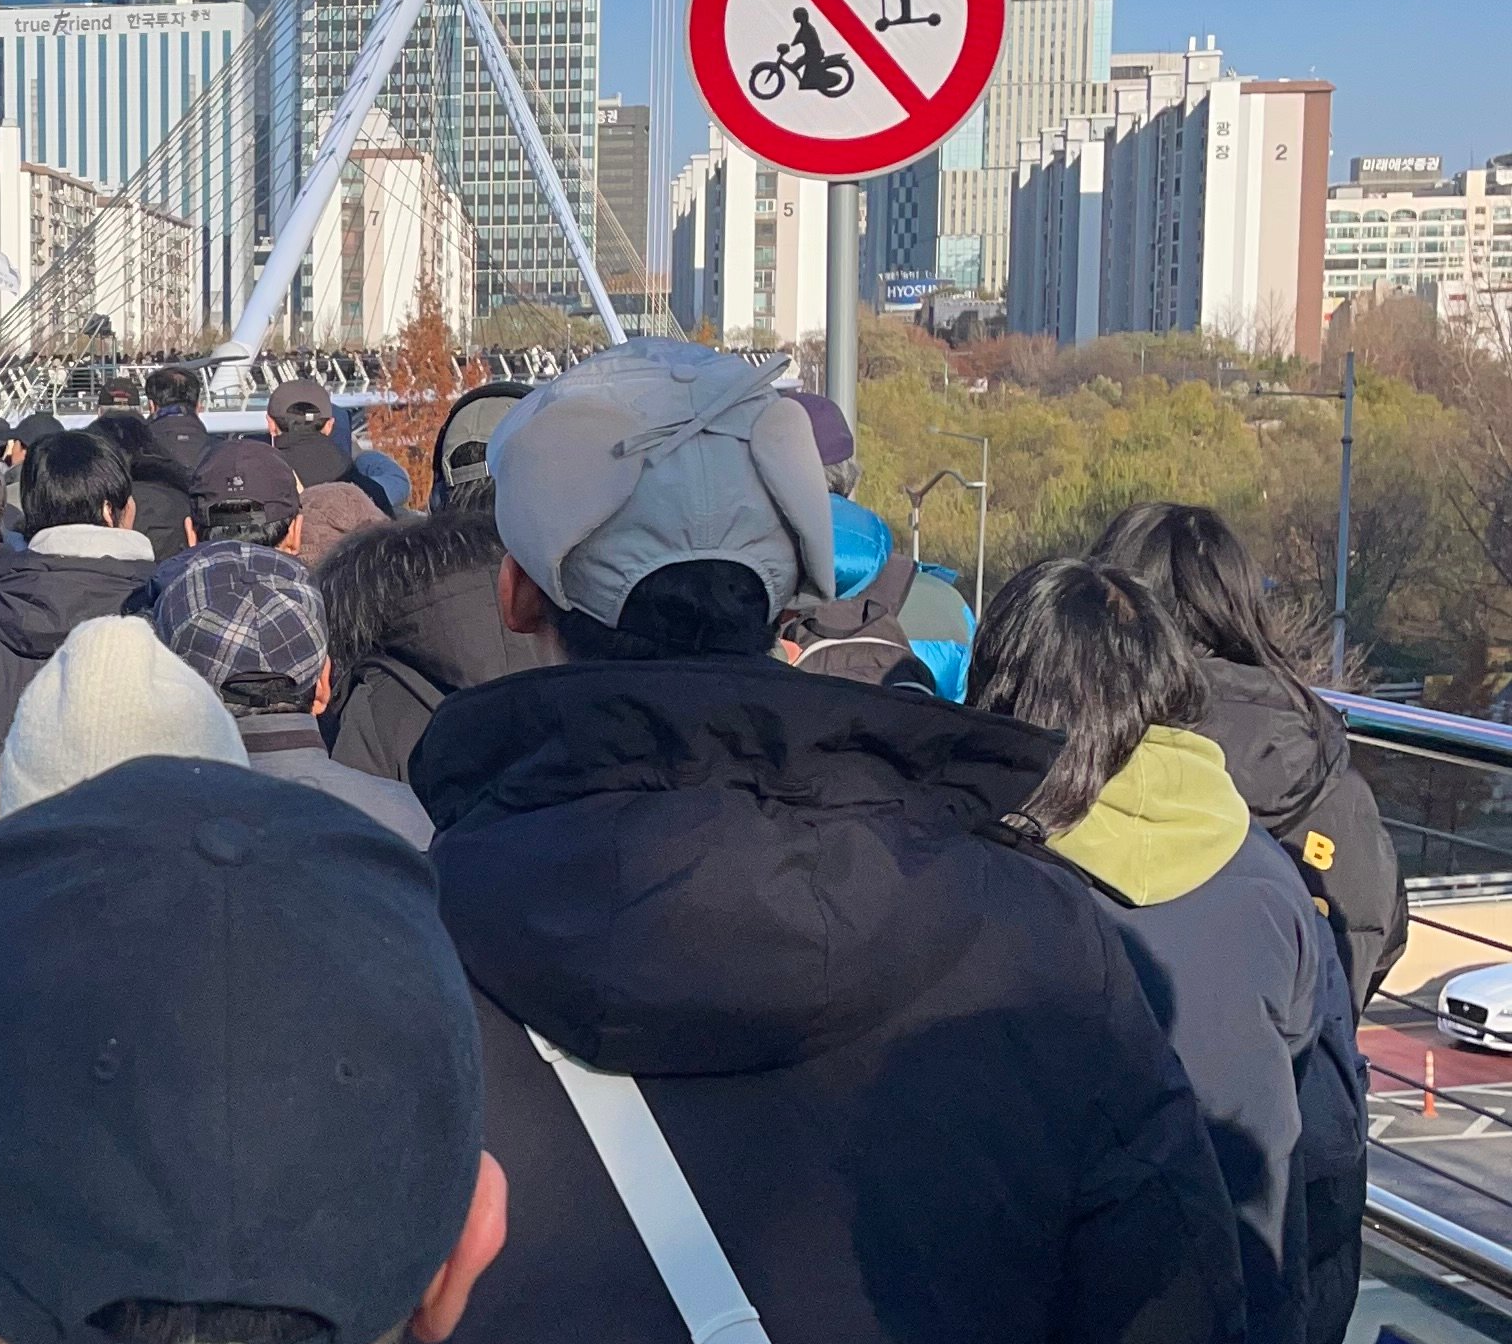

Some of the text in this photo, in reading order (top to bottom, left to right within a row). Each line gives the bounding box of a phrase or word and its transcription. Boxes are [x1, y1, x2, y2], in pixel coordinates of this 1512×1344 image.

[14, 17, 50, 33] true
[127, 12, 186, 29] 한국투자
[1275, 143, 1288, 161] 2
[1362, 157, 1440, 172] 미래에셋증권
[783, 202, 794, 217] 5
[369, 210, 380, 226] 7
[1303, 830, 1336, 871] B
